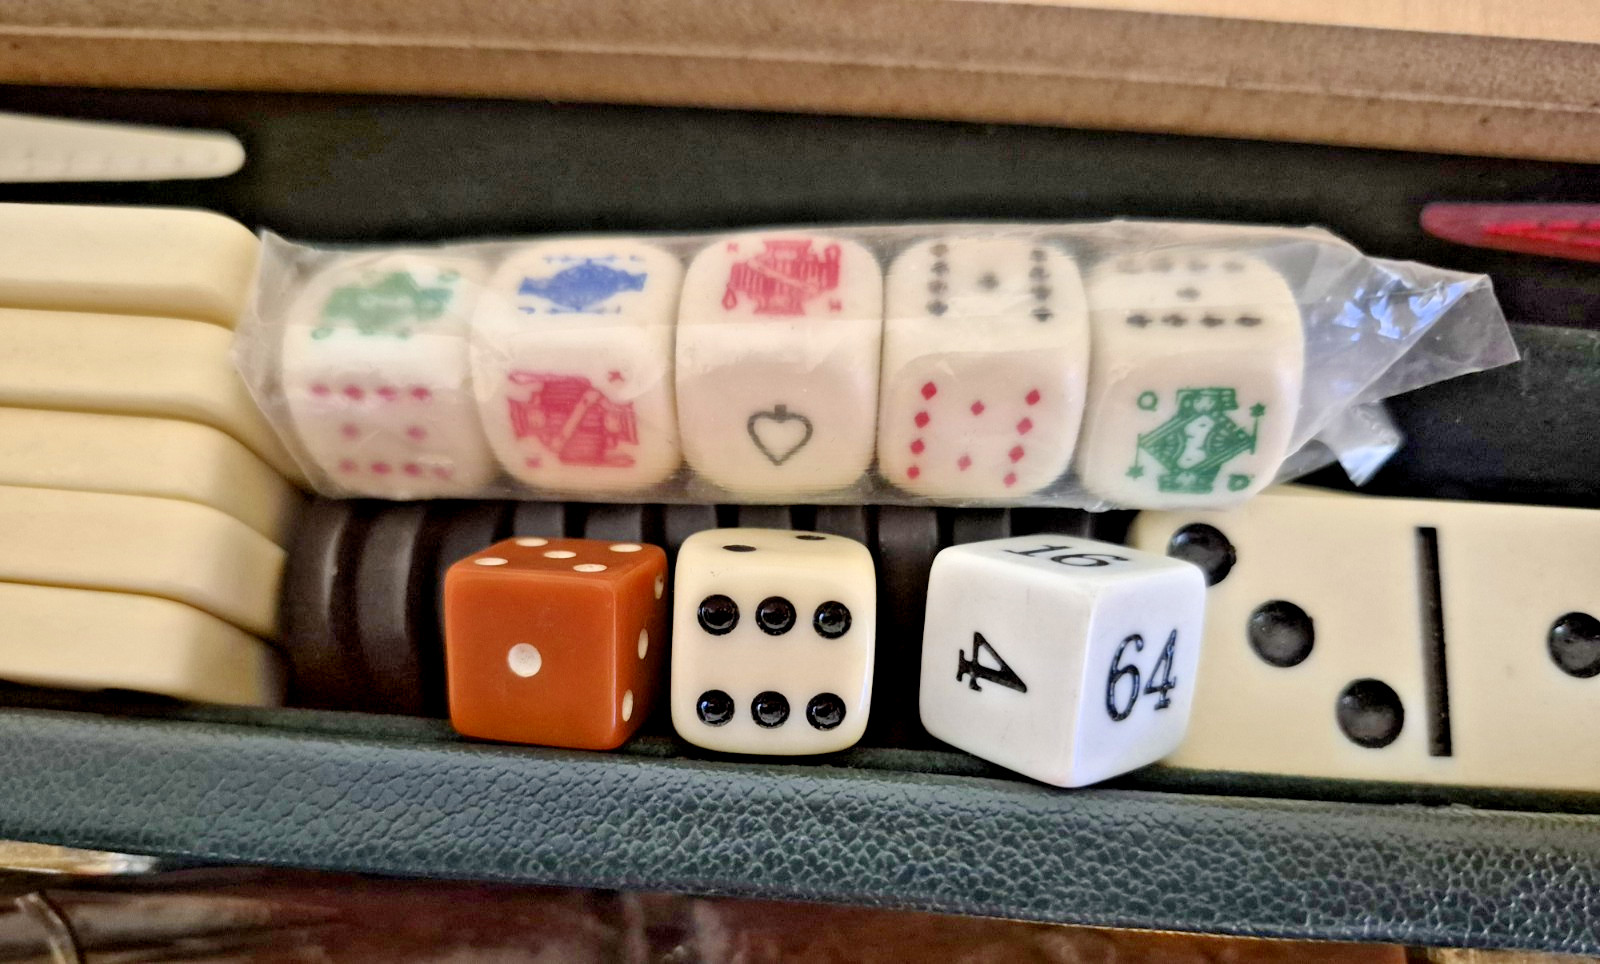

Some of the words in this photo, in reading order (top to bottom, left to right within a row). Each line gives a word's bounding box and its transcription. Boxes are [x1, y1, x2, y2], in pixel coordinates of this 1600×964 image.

[1136, 391, 1158, 411] Q
[1001, 544, 1129, 567] 16
[956, 631, 1028, 692] 4
[1106, 628, 1178, 722] 64
